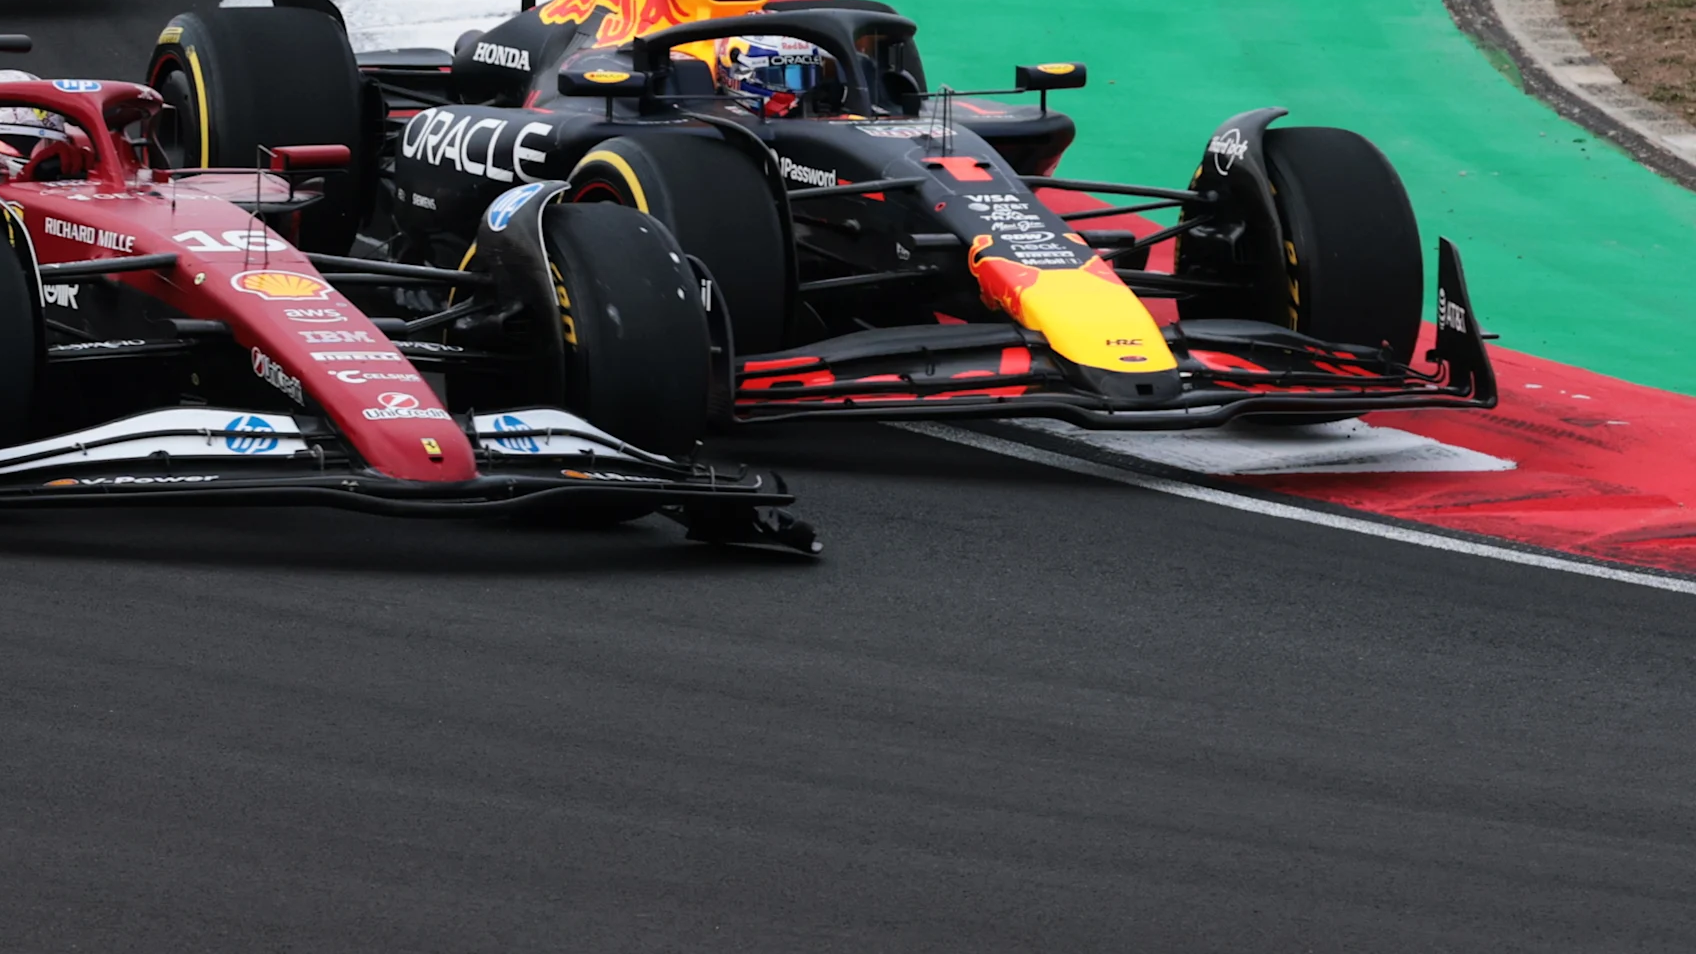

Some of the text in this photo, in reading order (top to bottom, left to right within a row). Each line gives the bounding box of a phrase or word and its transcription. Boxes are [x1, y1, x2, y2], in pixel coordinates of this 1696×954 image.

[472, 42, 531, 72] HONDA
[771, 55, 822, 66] ORACLE
[402, 108, 554, 184] ORACLE
[780, 156, 837, 188] 1Password
[920, 156, 994, 181] 1
[963, 194, 1020, 202] VISA
[44, 216, 136, 254] RICHARD MILLE
[173, 229, 288, 253] 16
[284, 308, 344, 320] aws
[298, 330, 376, 344] IBM
[309, 351, 402, 362] PIRELLI
[362, 372, 421, 381] CELSIUS
[362, 407, 452, 421] UniCredit
[225, 415, 279, 454] hp
[81, 473, 219, 486] V-Power
